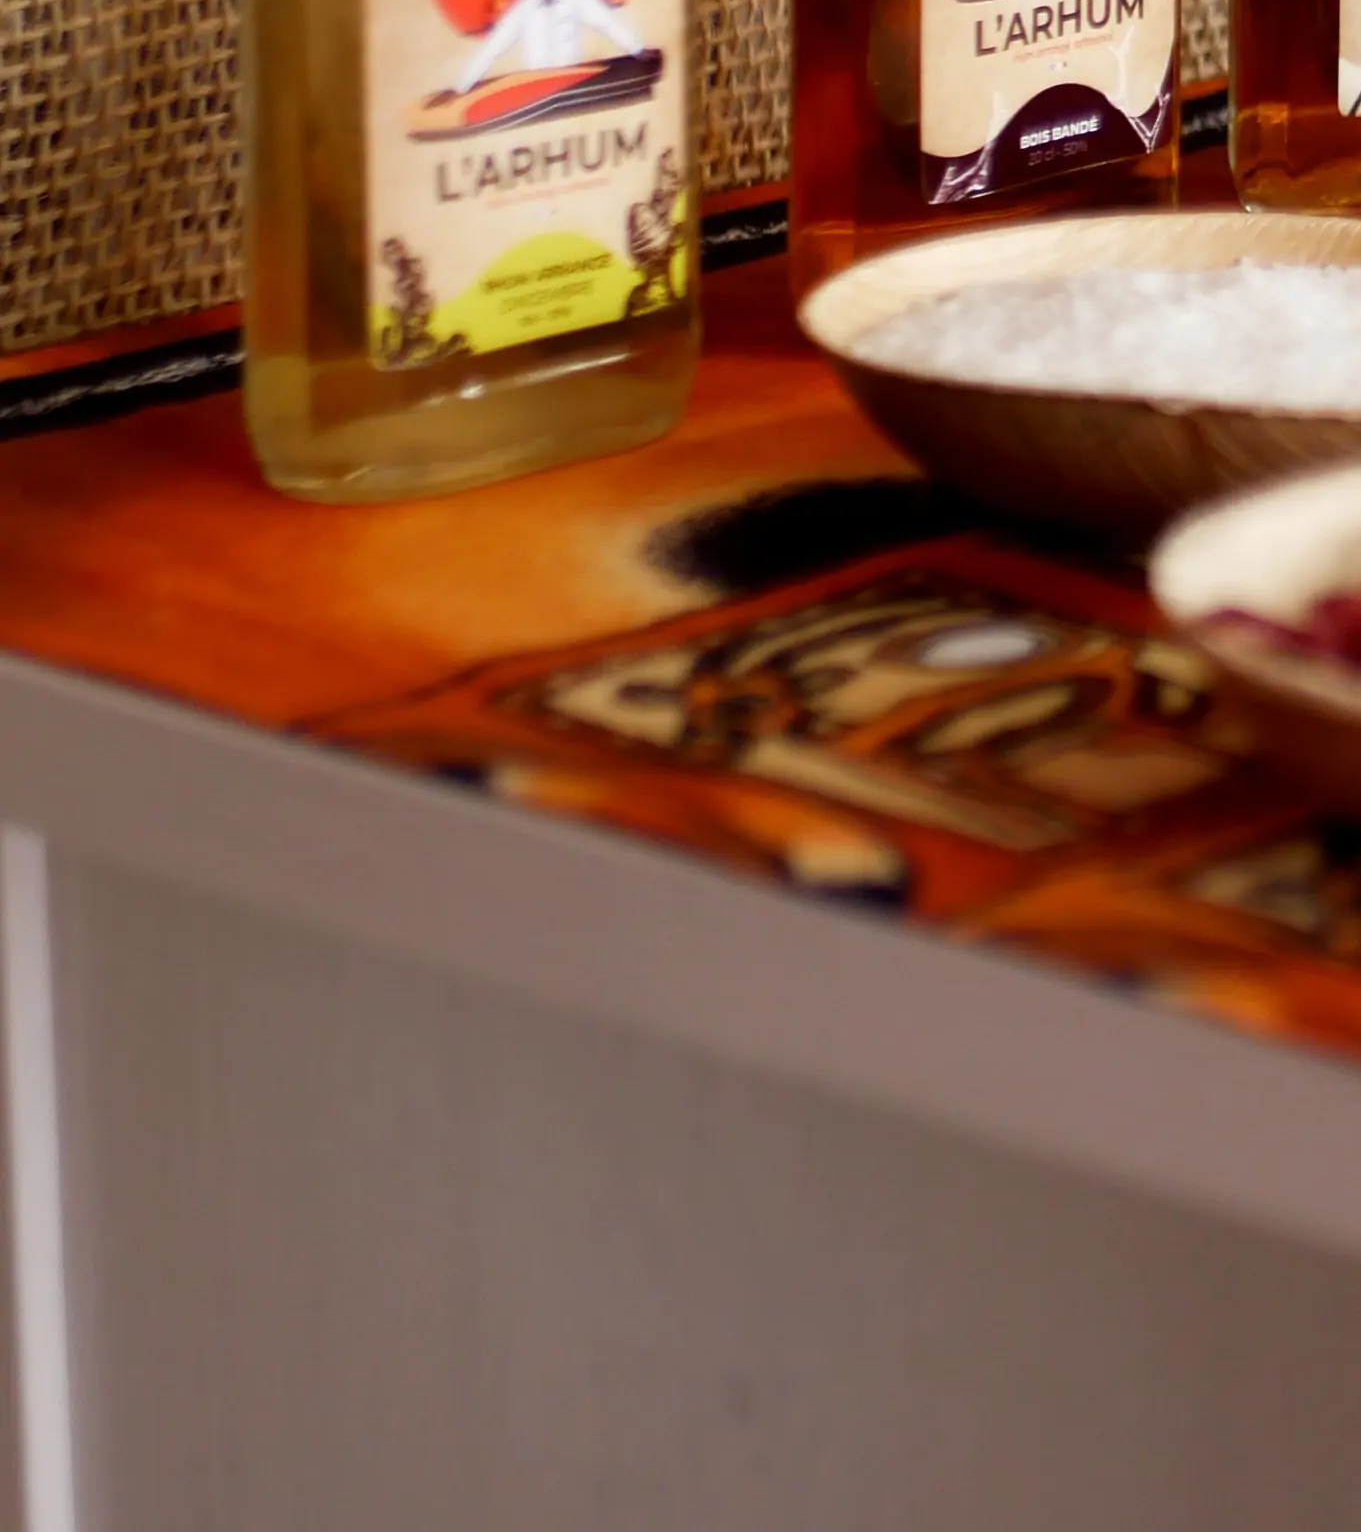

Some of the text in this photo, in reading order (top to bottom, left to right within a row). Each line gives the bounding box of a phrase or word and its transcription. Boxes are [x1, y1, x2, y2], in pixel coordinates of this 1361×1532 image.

[1019, 114, 1100, 150] BOIS BANDÉ
[434, 121, 649, 205] L'ARHUM
